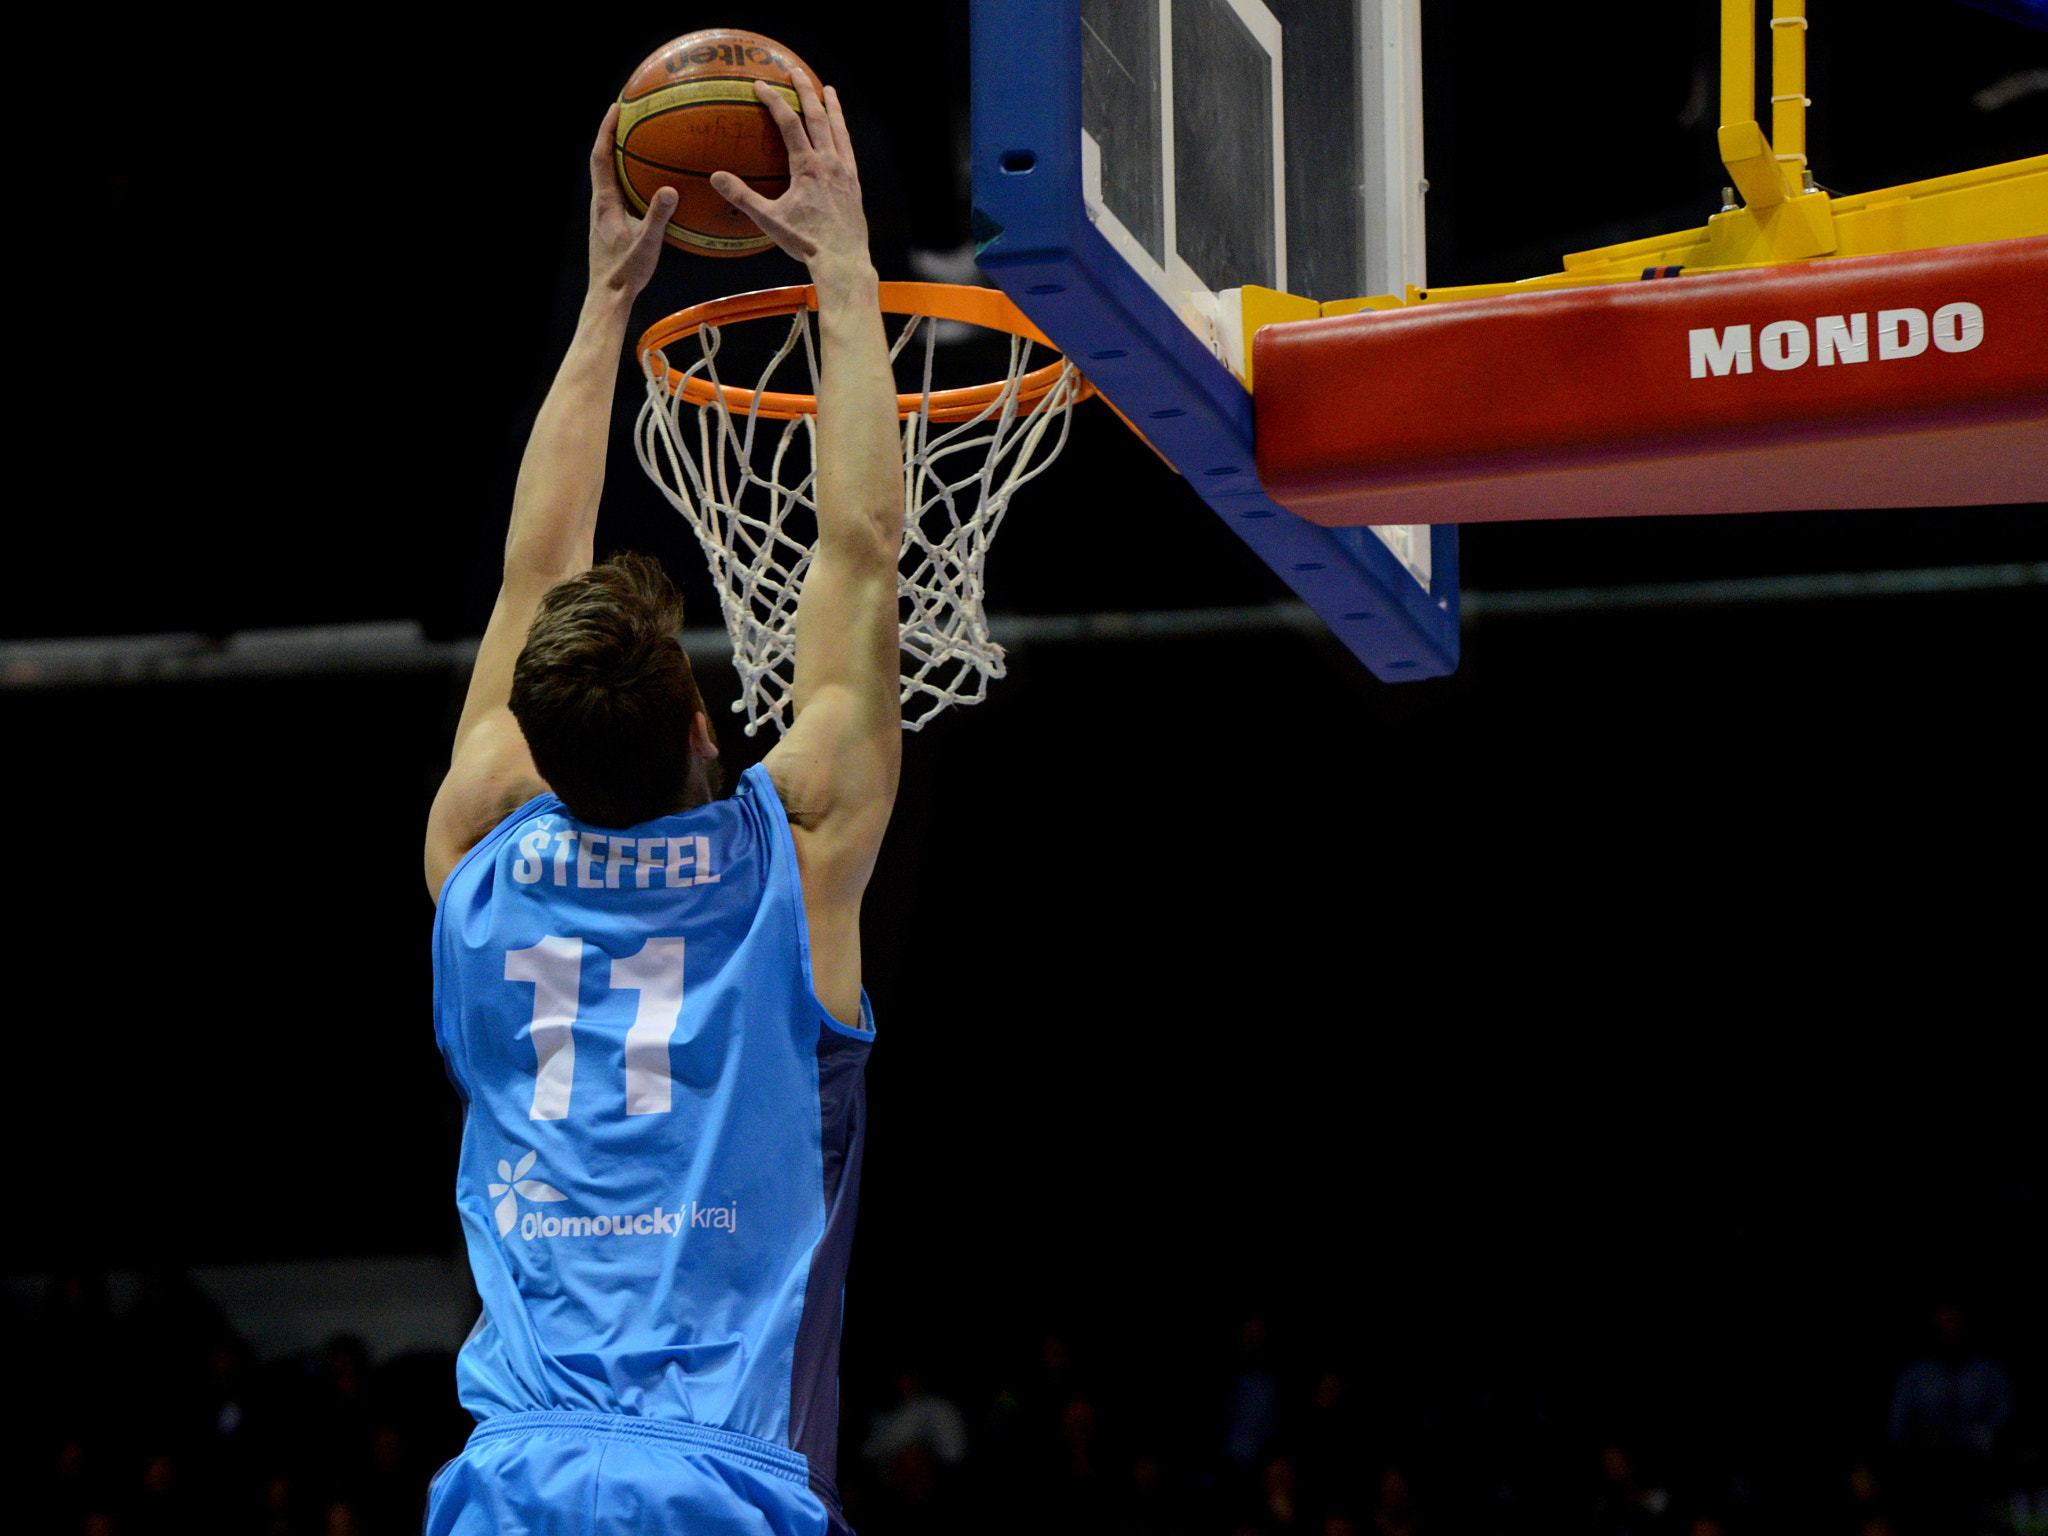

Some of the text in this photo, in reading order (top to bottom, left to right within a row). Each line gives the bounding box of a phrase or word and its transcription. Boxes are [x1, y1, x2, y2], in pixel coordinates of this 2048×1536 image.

[1688, 302, 1984, 379] MONDO
[512, 819, 720, 889] ŠTEFFEL
[504, 934, 685, 1121] 11
[521, 1201, 737, 1240] Olomoucký kraj
